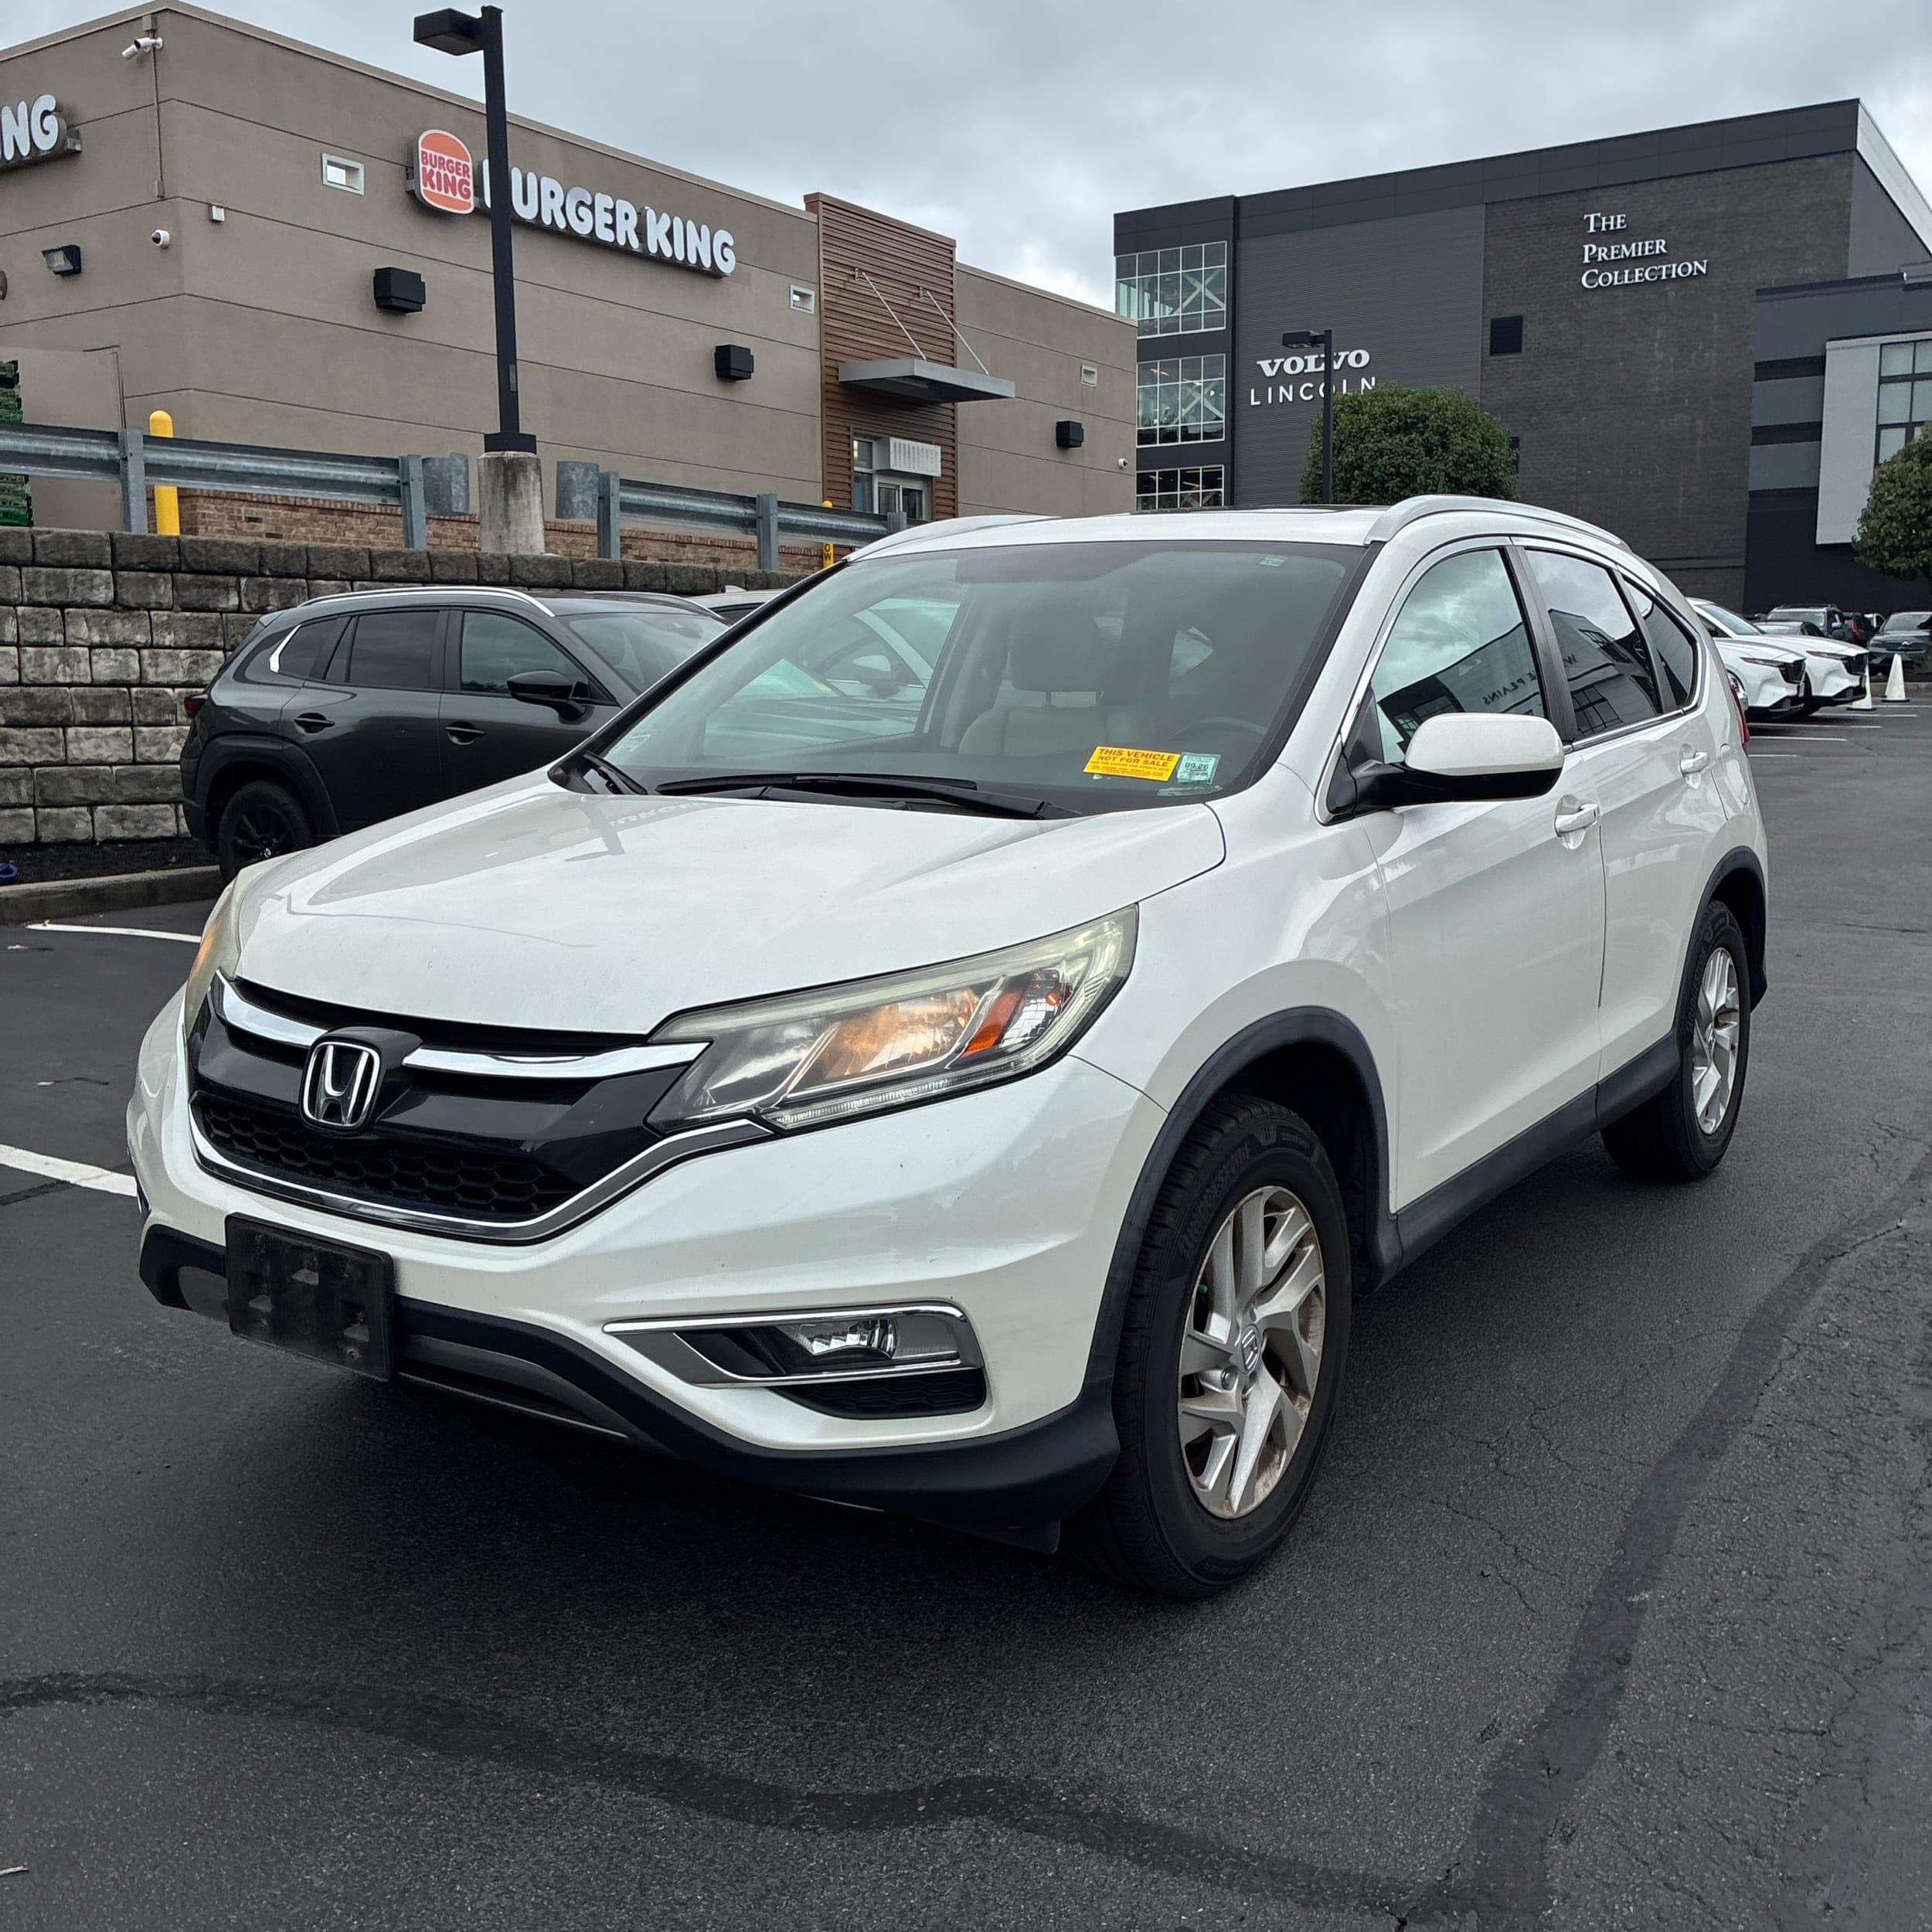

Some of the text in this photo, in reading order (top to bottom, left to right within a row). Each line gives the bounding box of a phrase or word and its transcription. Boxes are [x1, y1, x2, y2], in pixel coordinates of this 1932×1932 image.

[0, 94, 59, 160] NG
[421, 151, 471, 179] BURGER
[422, 167, 471, 199] KING
[1583, 213, 1627, 233] THE
[646, 208, 736, 274] KING
[1583, 239, 1667, 264] PREMIER
[1581, 260, 1708, 288] COLLECTION
[1257, 349, 1370, 376] VOLVO
[1127, 750, 1175, 761] VEHICLE
